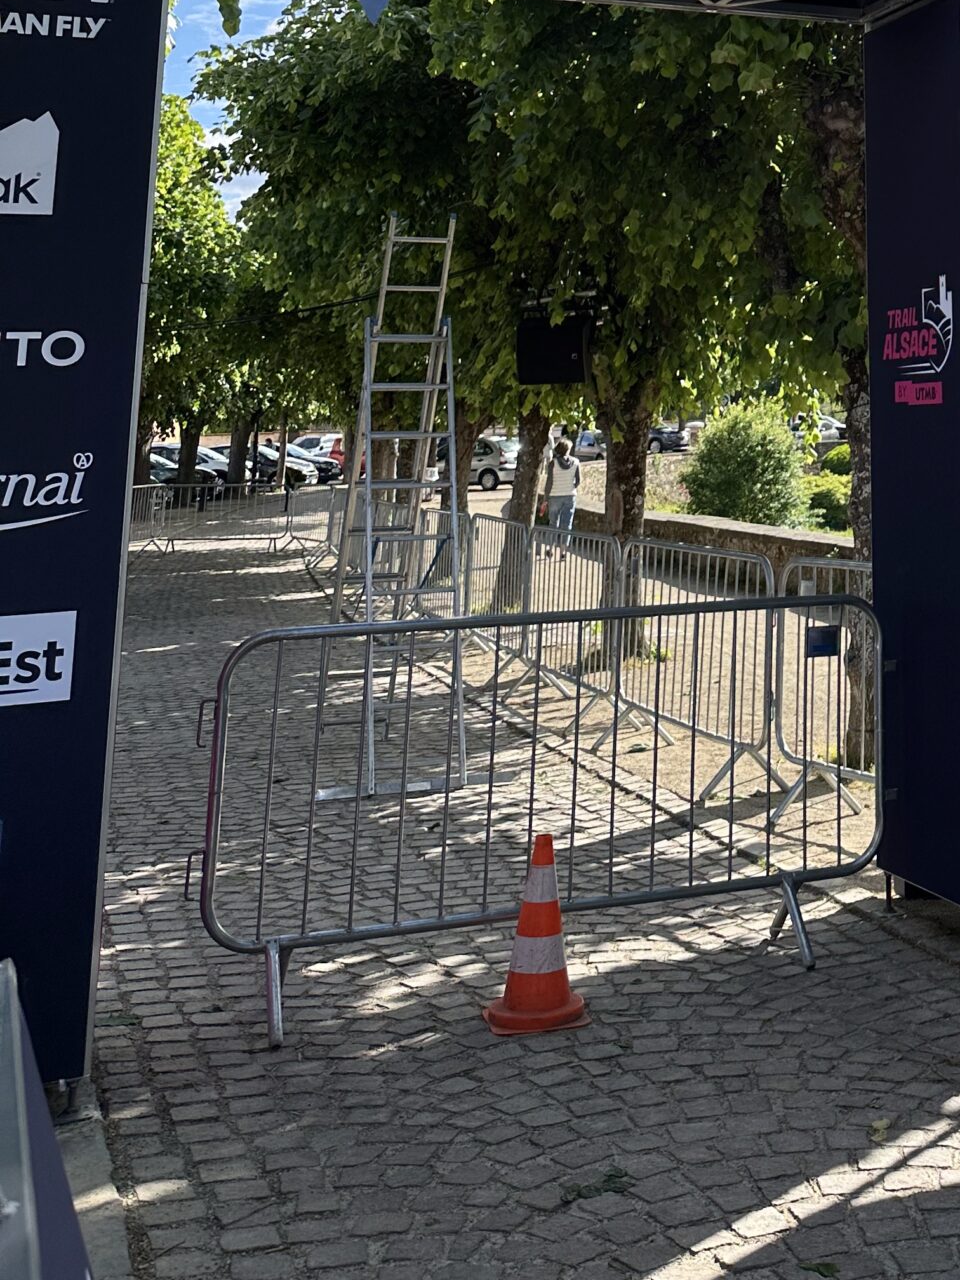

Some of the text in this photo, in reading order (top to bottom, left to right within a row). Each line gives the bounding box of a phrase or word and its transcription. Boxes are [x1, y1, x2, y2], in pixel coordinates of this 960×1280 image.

[56, 15, 107, 38] FLY
[888, 307, 919, 329] TRAIL
[0, 330, 85, 367] TO
[883, 328, 938, 361] ALSACE
[914, 386, 937, 401] UTMB
